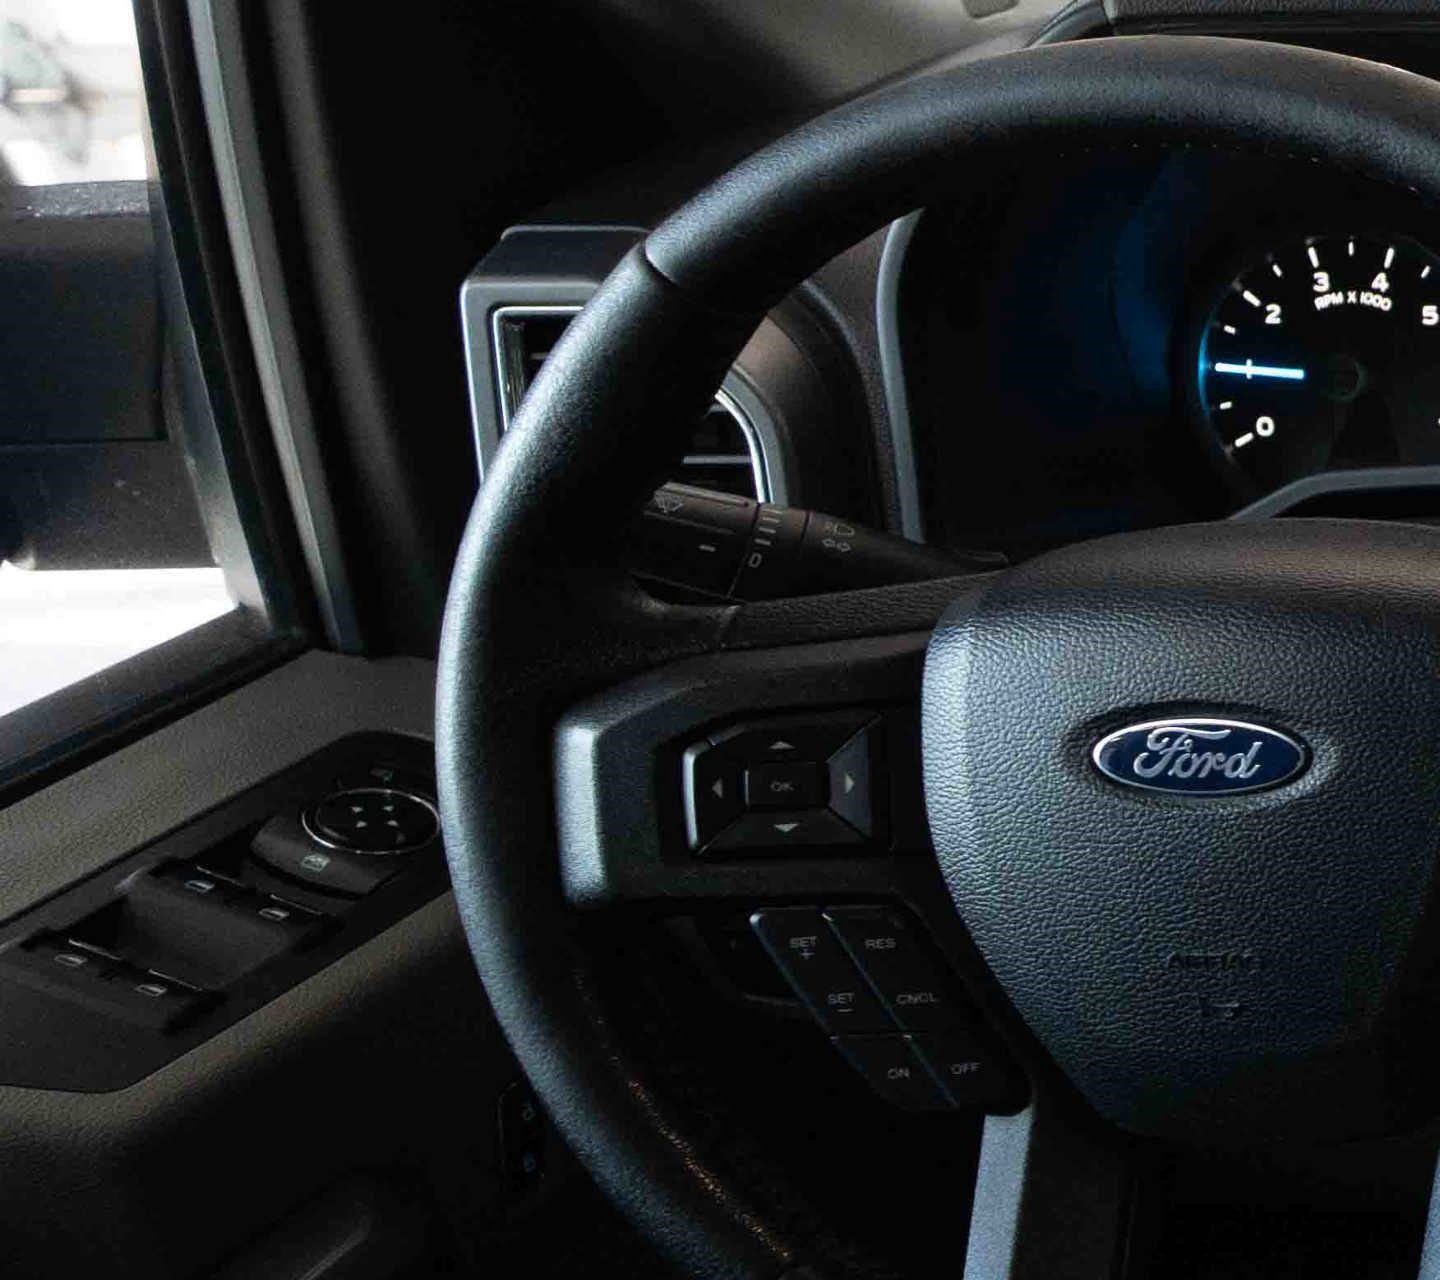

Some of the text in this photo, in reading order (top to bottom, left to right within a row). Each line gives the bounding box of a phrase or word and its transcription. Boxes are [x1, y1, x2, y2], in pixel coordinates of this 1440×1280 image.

[1313, 272, 1329, 292] 3
[1372, 272, 1390, 291] 4
[1314, 291, 1343, 310] RPM
[1360, 291, 1392, 311] 1000
[1265, 304, 1281, 324] 2
[1422, 305, 1440, 325] 5
[1256, 416, 1274, 436] 0
[1133, 726, 1263, 779] Ford
[770, 780, 795, 792] OK
[790, 936, 816, 948] SET
[864, 938, 896, 949] RES
[828, 992, 855, 1004] SET
[896, 992, 938, 1005] CNCL
[888, 1068, 910, 1080] ON
[952, 1062, 980, 1075] OFF
